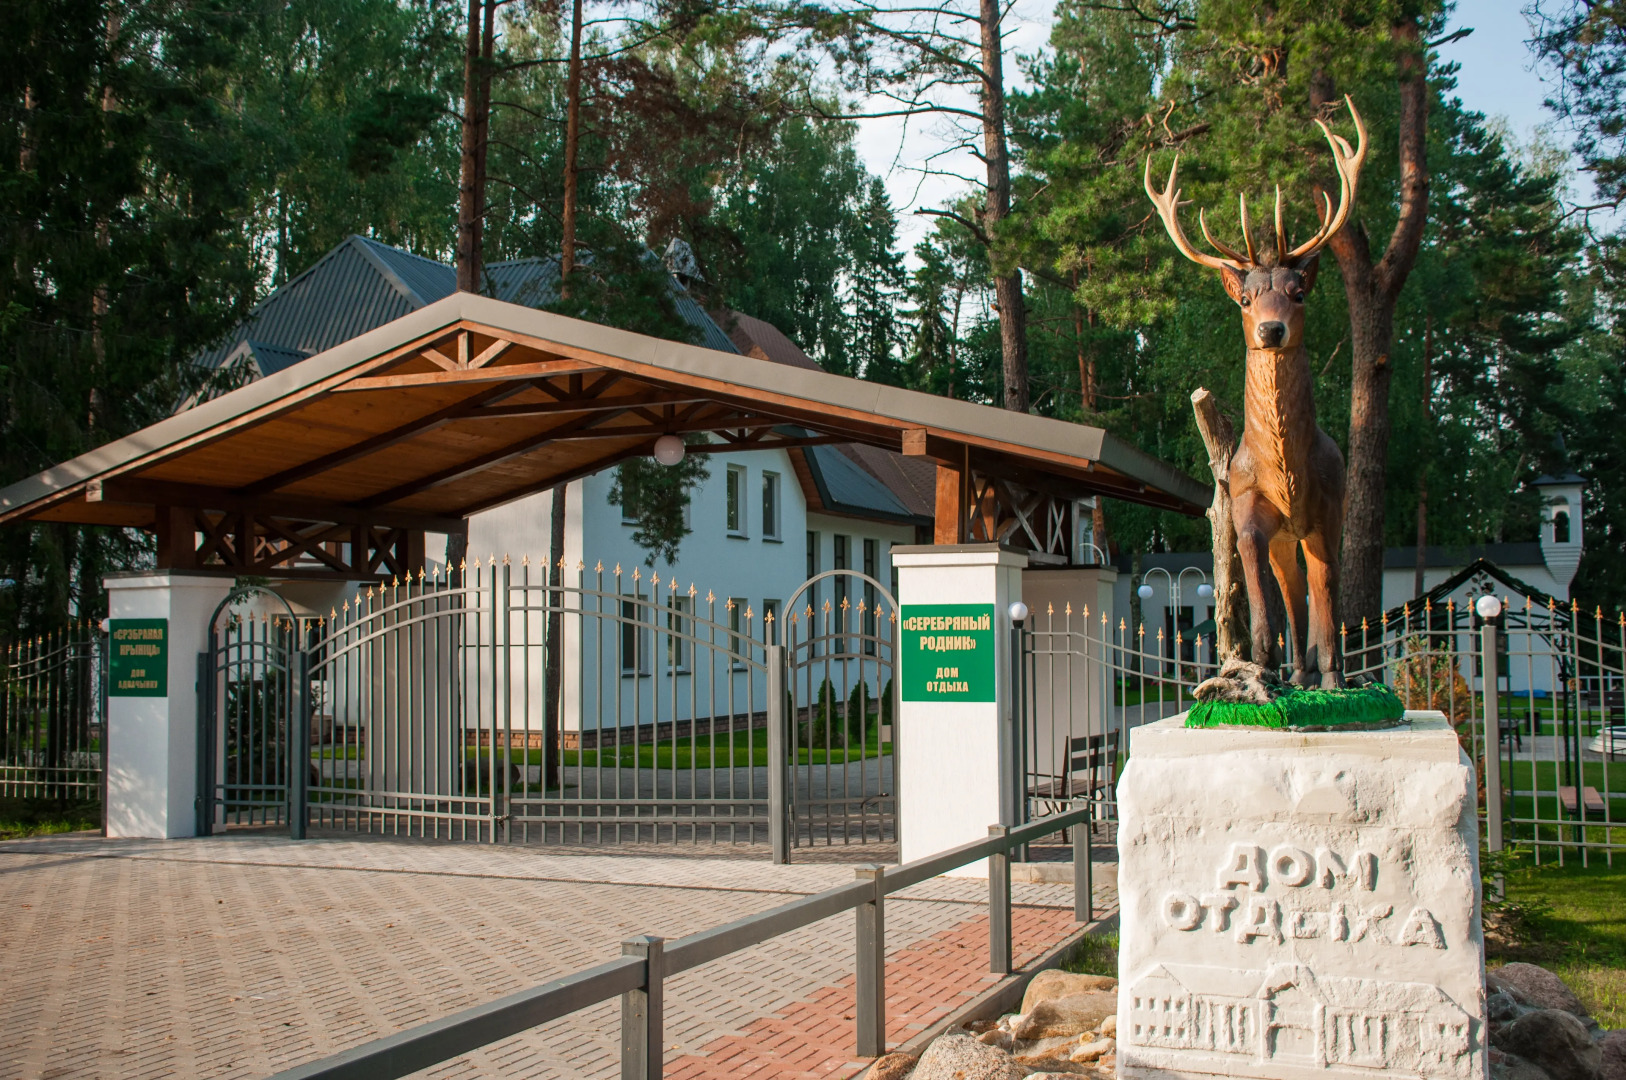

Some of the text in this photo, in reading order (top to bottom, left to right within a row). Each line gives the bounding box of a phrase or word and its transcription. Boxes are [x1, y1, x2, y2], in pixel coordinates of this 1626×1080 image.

[903, 613, 991, 631] «СЕРЕБРЯНЫЙ
[920, 635, 976, 652] РОДНИК»
[936, 667, 959, 679] ДОМ
[926, 681, 969, 693] ОТДЫХА
[1216, 843, 1377, 892] ДОМ
